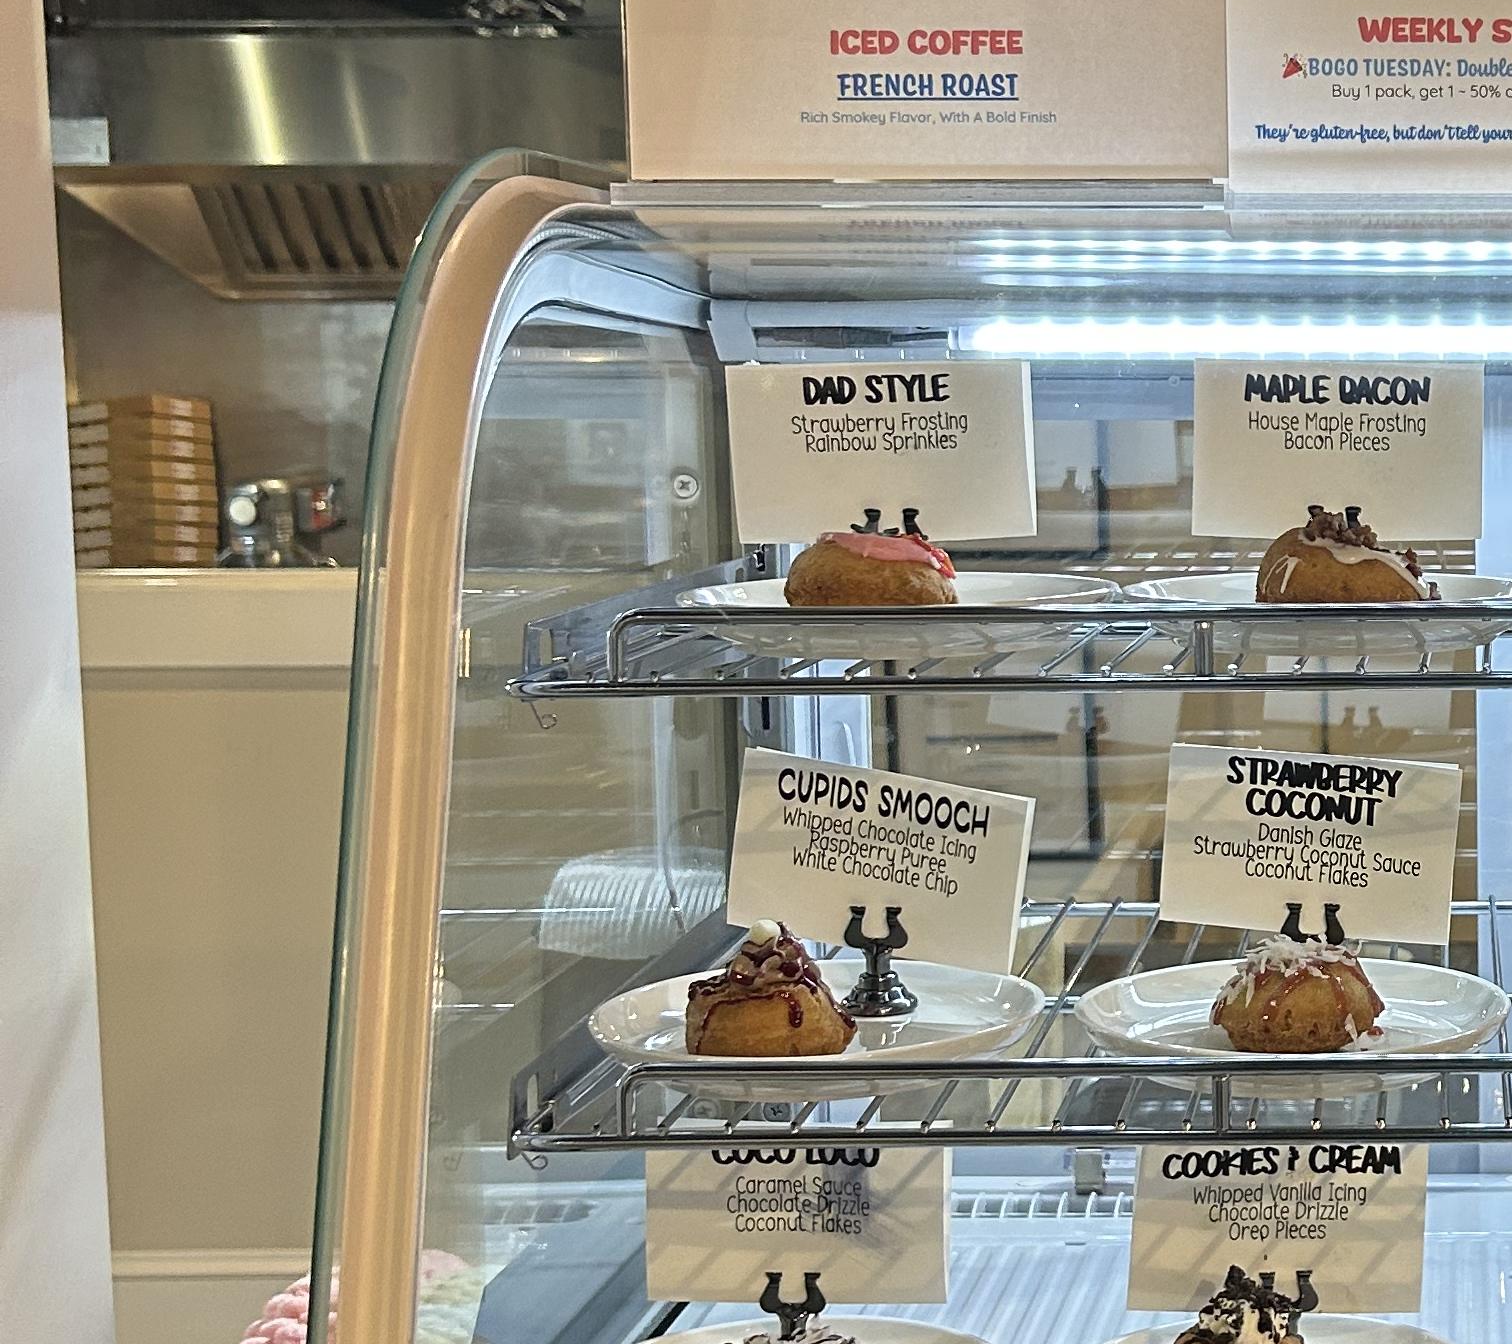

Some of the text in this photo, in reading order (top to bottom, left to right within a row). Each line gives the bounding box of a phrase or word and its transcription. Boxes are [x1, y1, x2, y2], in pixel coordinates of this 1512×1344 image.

[830, 30, 1023, 55] ICED COFFEE
[1358, 17, 1483, 43] WEEKLY
[1308, 58, 1358, 76] BOGO
[1363, 59, 1451, 77] TUESDAY:
[837, 74, 1018, 96] FRENCH ROAST
[803, 374, 950, 405] DAD STYLE
[1244, 374, 1431, 405] MAPLE BACON
[791, 411, 967, 434] Strawberry Frosting
[806, 432, 957, 454] Rainbow Sprinkles
[1227, 756, 1402, 797] STRAWBERRY
[778, 768, 990, 837] CUPIDS SMOOCH
[1246, 788, 1382, 826] COCONUT
[1162, 1147, 1279, 1179] COOKIES
[1309, 1145, 1401, 1174] CREAM
